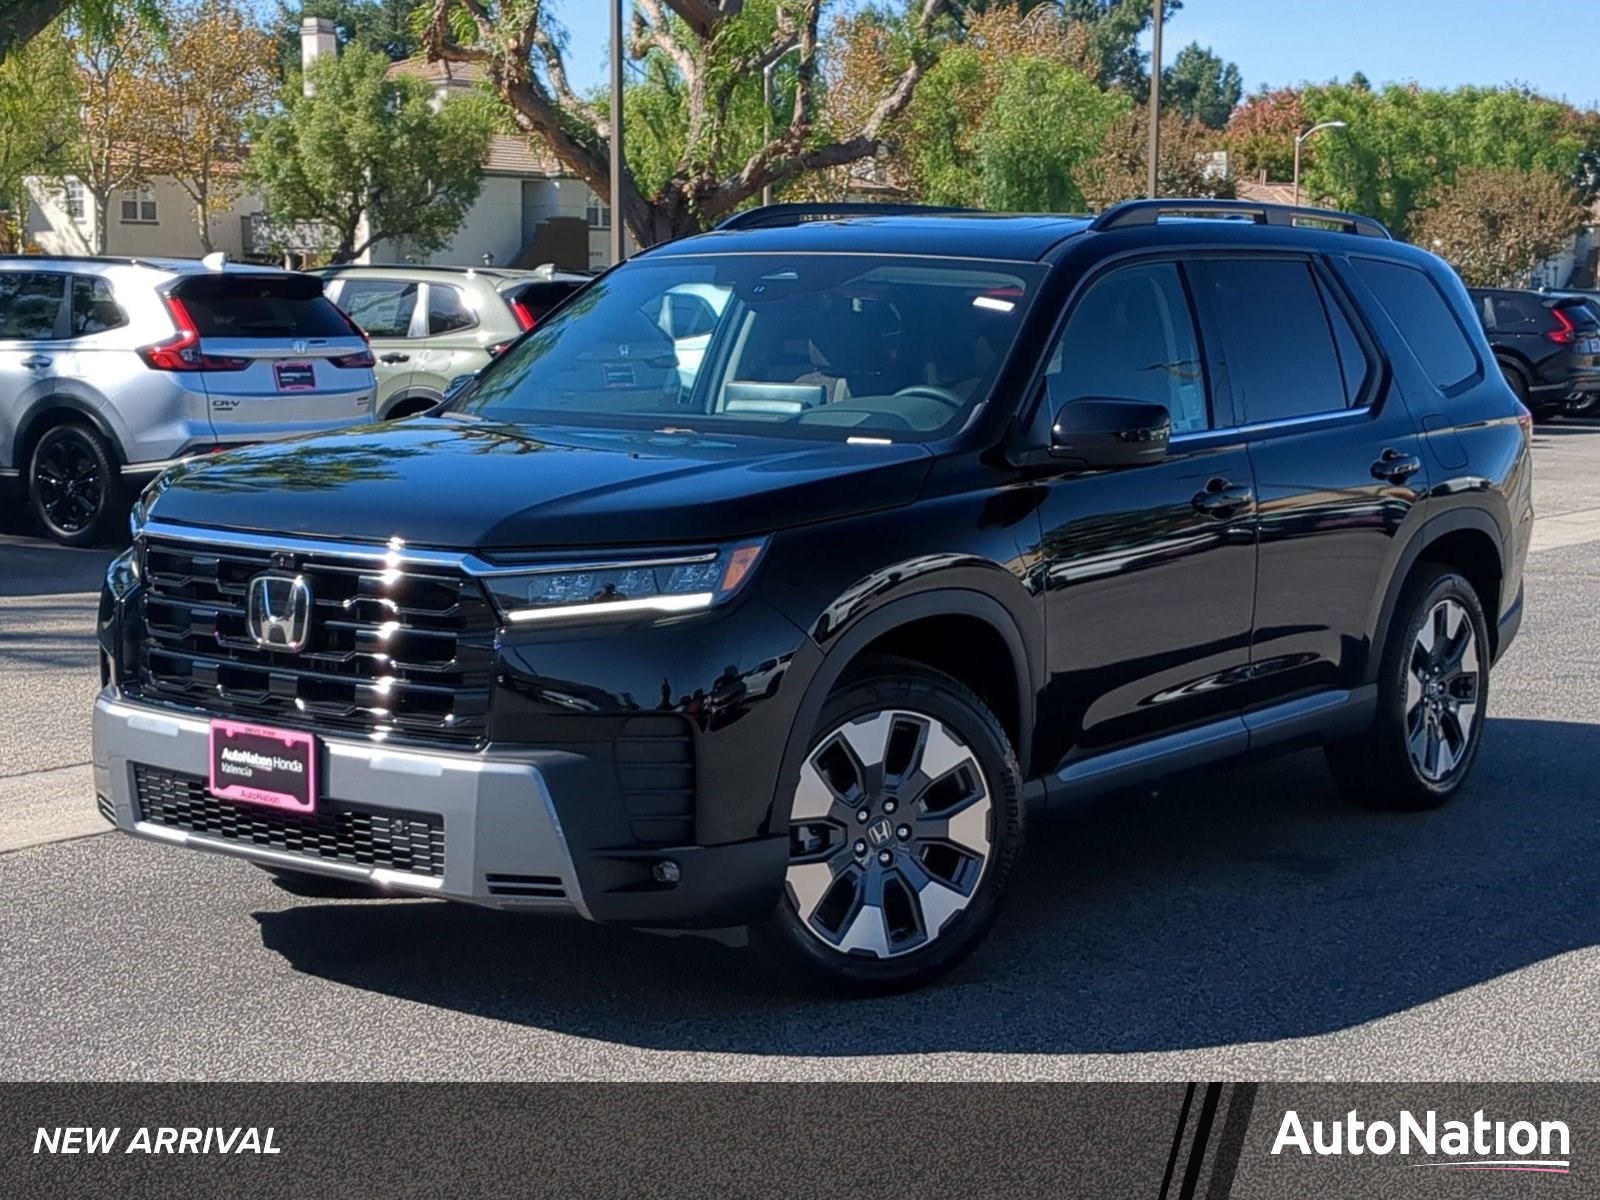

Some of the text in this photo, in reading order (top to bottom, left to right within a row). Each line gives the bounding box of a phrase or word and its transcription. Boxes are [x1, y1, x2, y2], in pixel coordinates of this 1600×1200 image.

[221, 747, 302, 773] AutoNation Honda
[221, 762, 253, 777] Valencia
[240, 790, 281, 804] AutoNation
